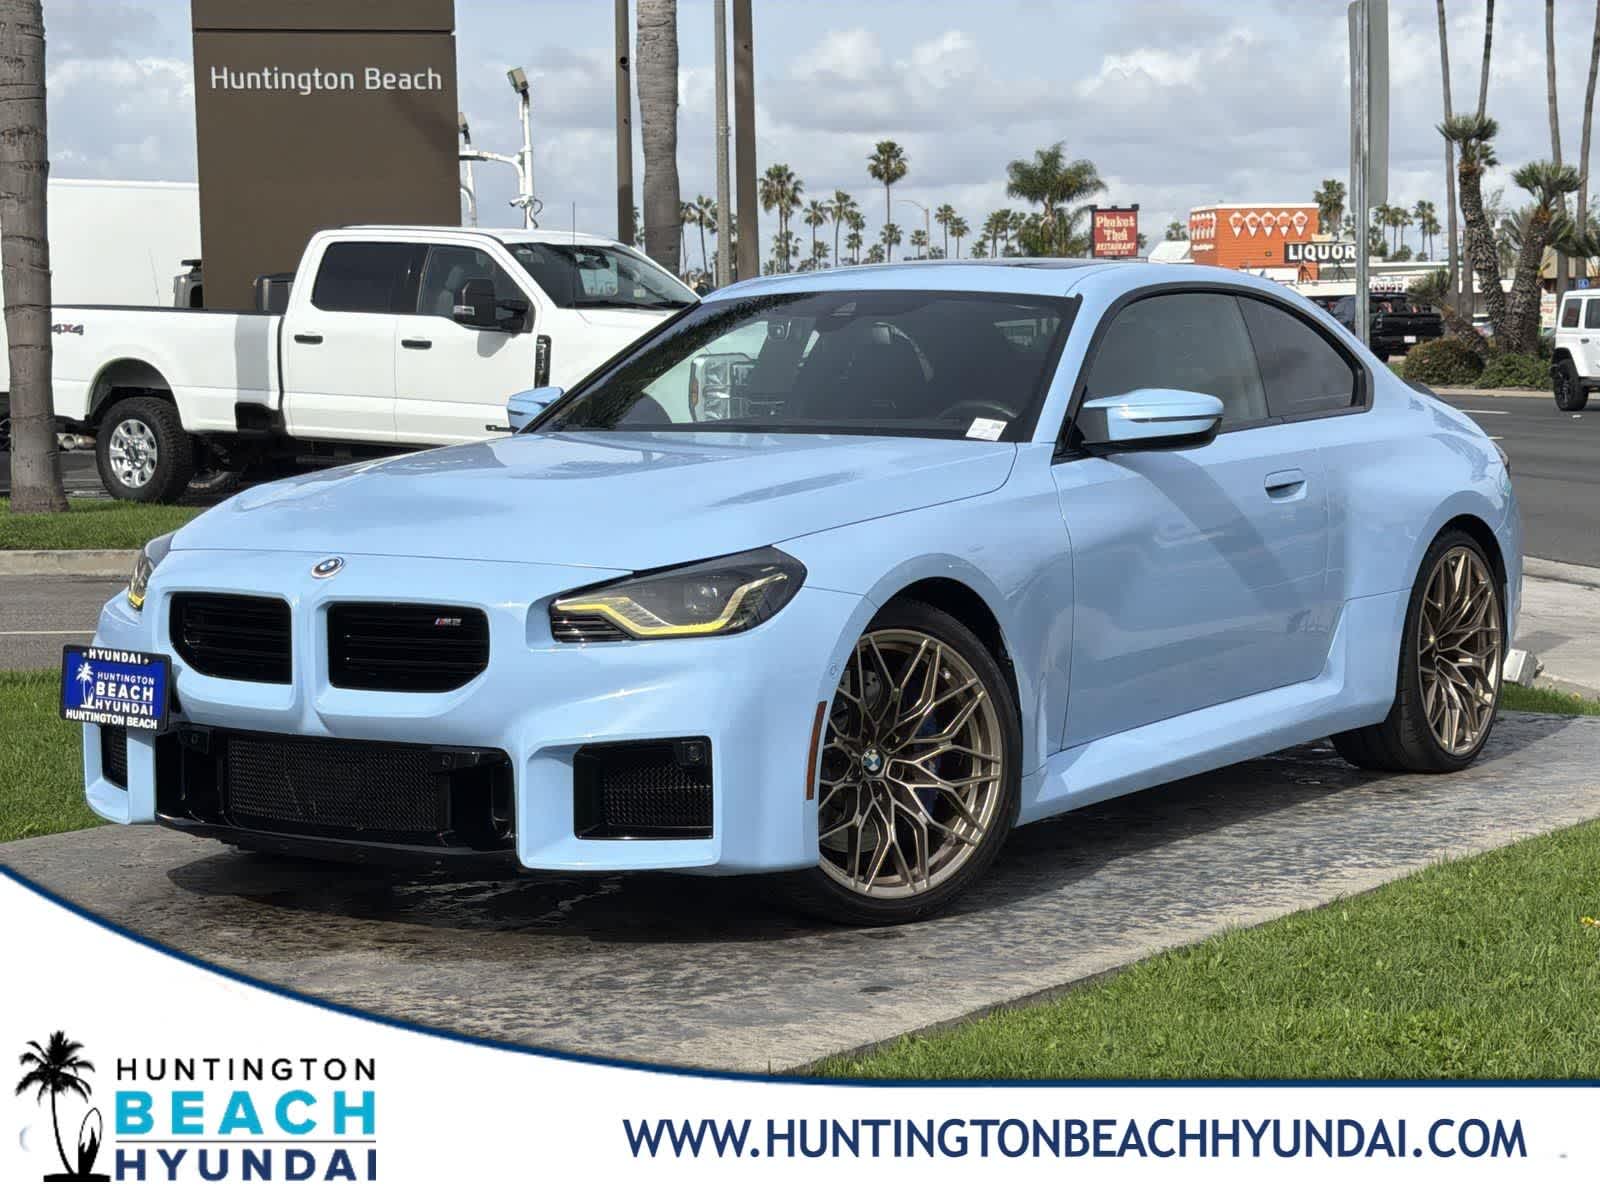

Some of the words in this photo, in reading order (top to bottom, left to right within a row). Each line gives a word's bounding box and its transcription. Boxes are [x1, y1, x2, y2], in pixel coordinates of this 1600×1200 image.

[211, 66, 354, 95] Huntington
[365, 67, 442, 90] Beach
[1288, 244, 1356, 261] LIQUOR
[89, 648, 141, 665] HYUNDAI
[97, 671, 155, 685] HUNTINGTON
[96, 682, 154, 701] BEACH
[95, 699, 153, 716] HYUNDAI
[66, 709, 124, 726] HUNTINGTON
[126, 716, 158, 730] BEACH
